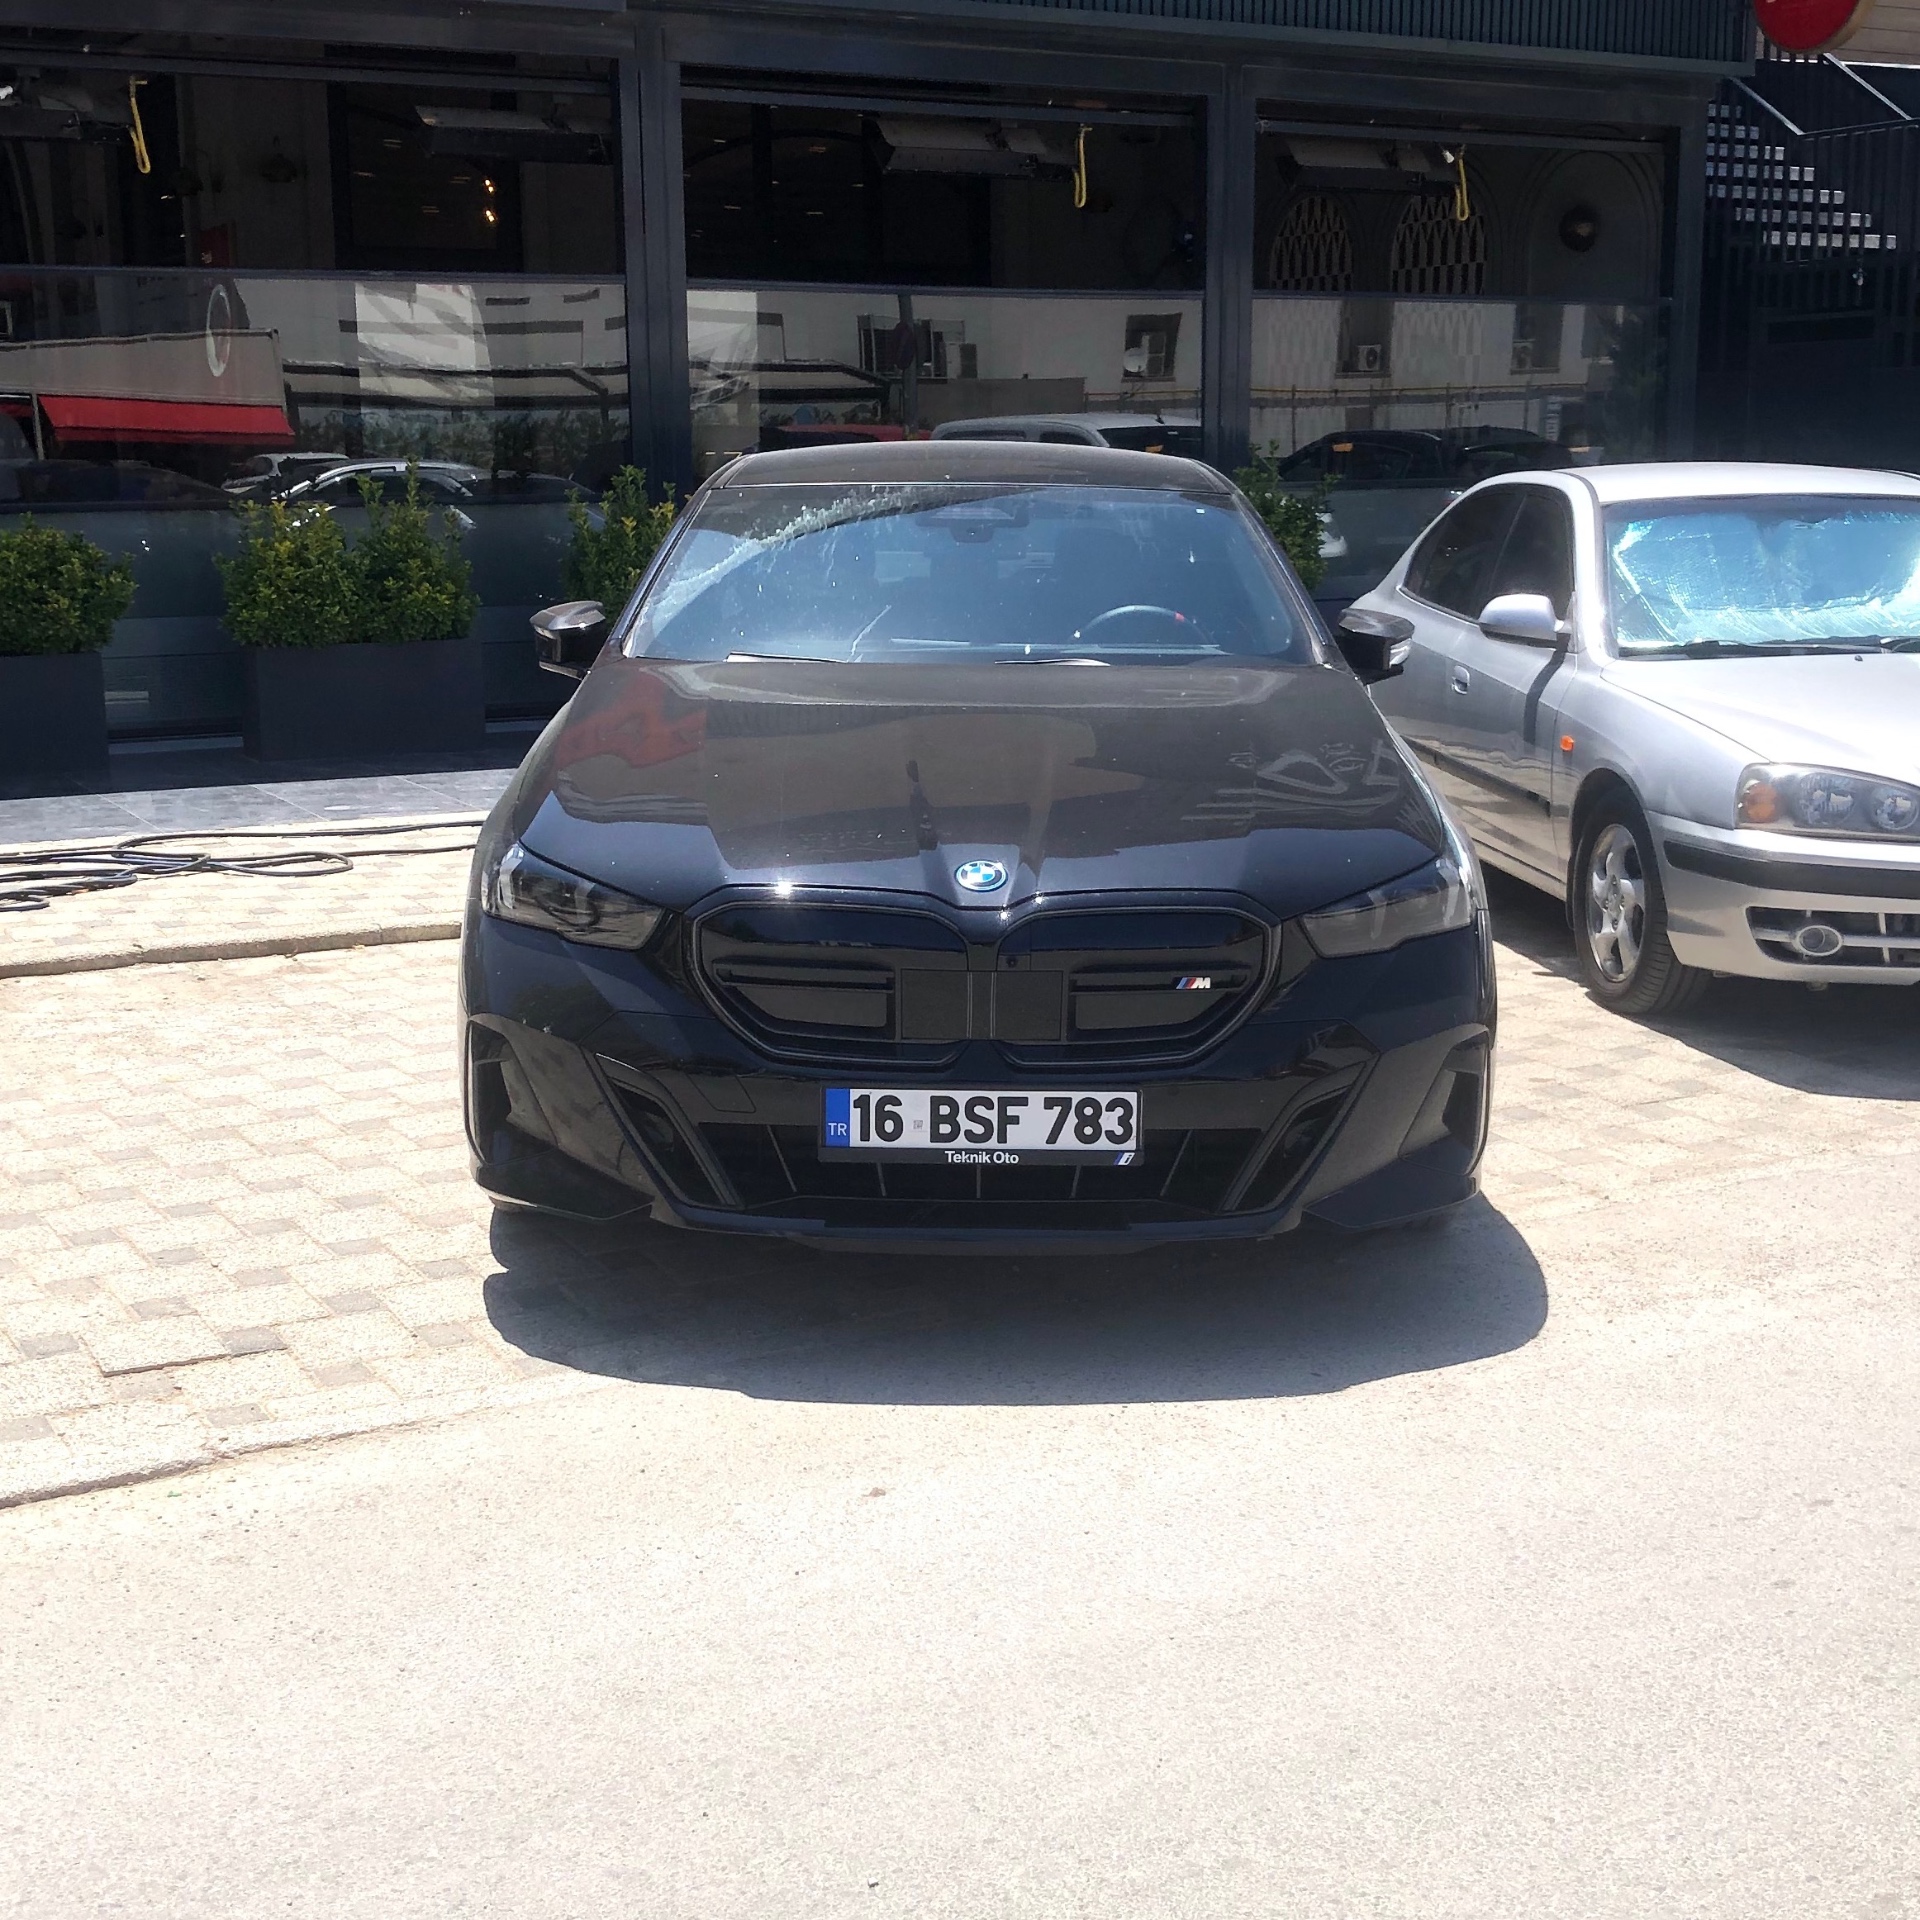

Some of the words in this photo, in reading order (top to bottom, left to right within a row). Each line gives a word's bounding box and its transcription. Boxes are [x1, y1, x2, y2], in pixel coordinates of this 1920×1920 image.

[853, 1094, 904, 1142] 16
[929, 1095, 1029, 1144] BSF
[1043, 1096, 1133, 1145] 783
[828, 1123, 847, 1136] TR
[945, 1151, 991, 1164] Teknik
[993, 1152, 1019, 1164] Oto
